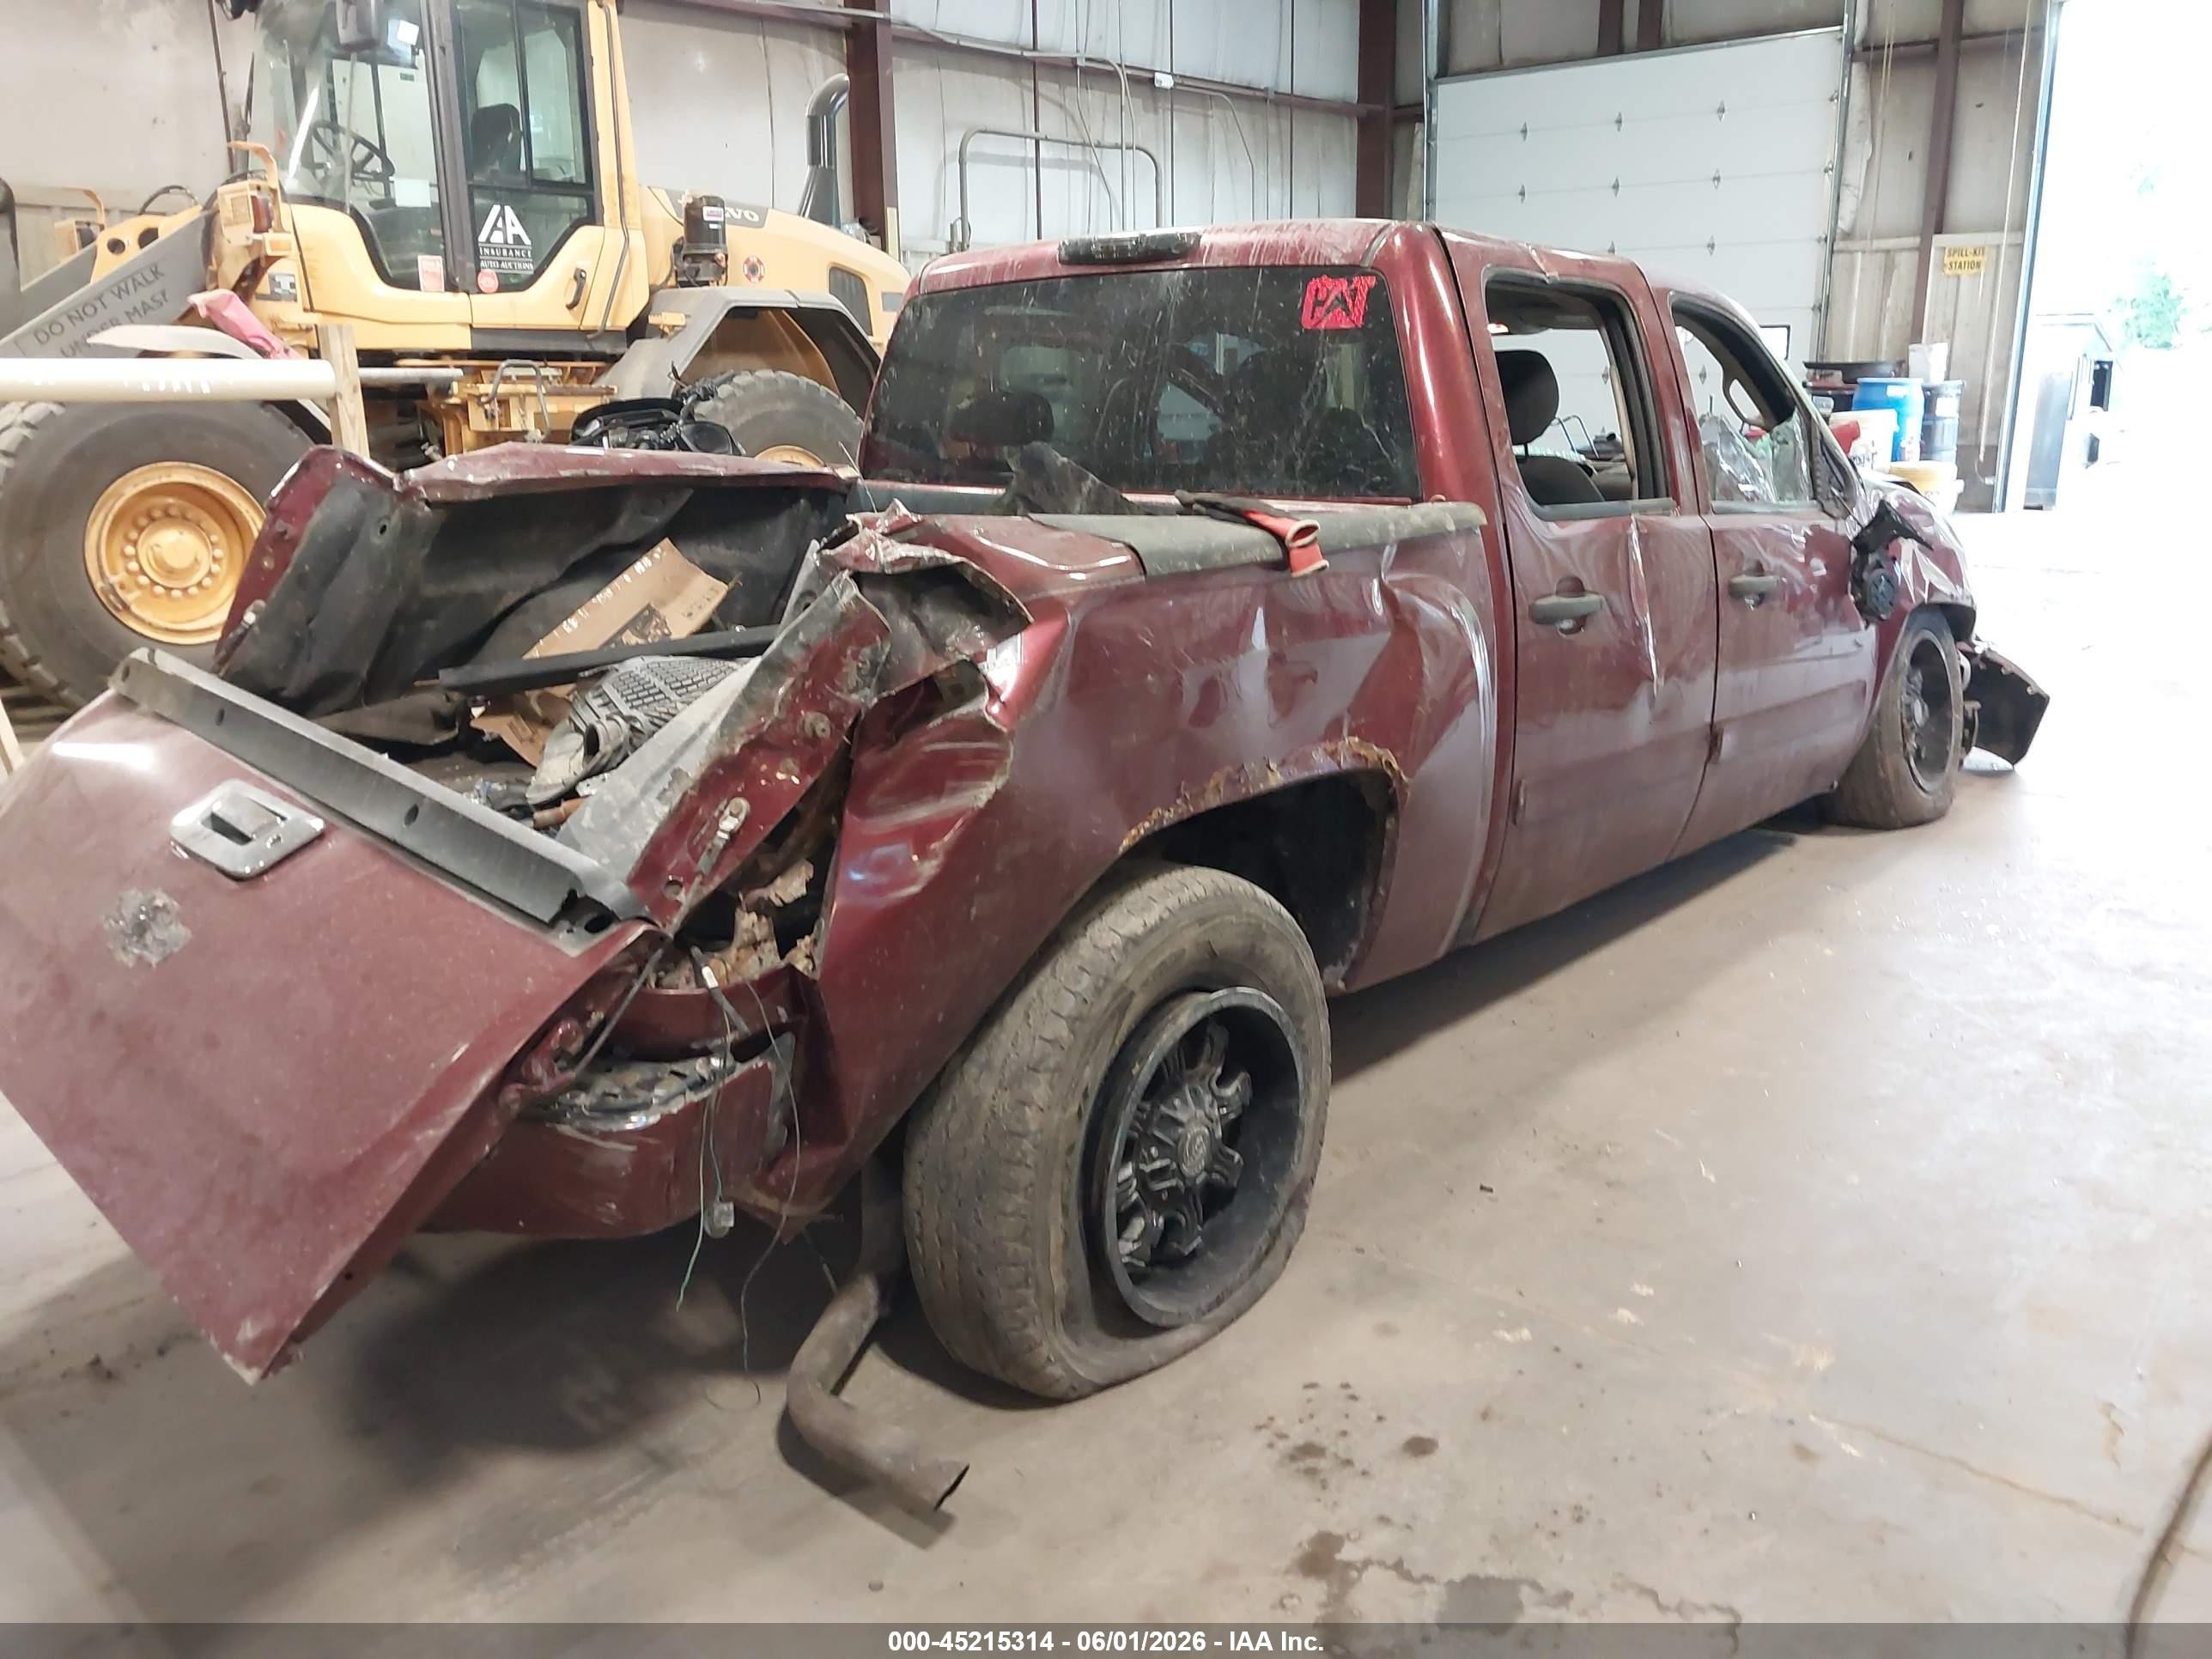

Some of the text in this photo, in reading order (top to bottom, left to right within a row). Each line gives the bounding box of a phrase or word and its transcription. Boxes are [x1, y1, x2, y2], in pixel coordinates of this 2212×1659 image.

[479, 246, 532, 258] INSURANCE
[1947, 246, 1985, 258] SPILL-KIT
[480, 259, 534, 270] AUTO AUCTIONS
[1948, 260, 1982, 270] STATION
[33, 263, 166, 345] DO NOT WALK
